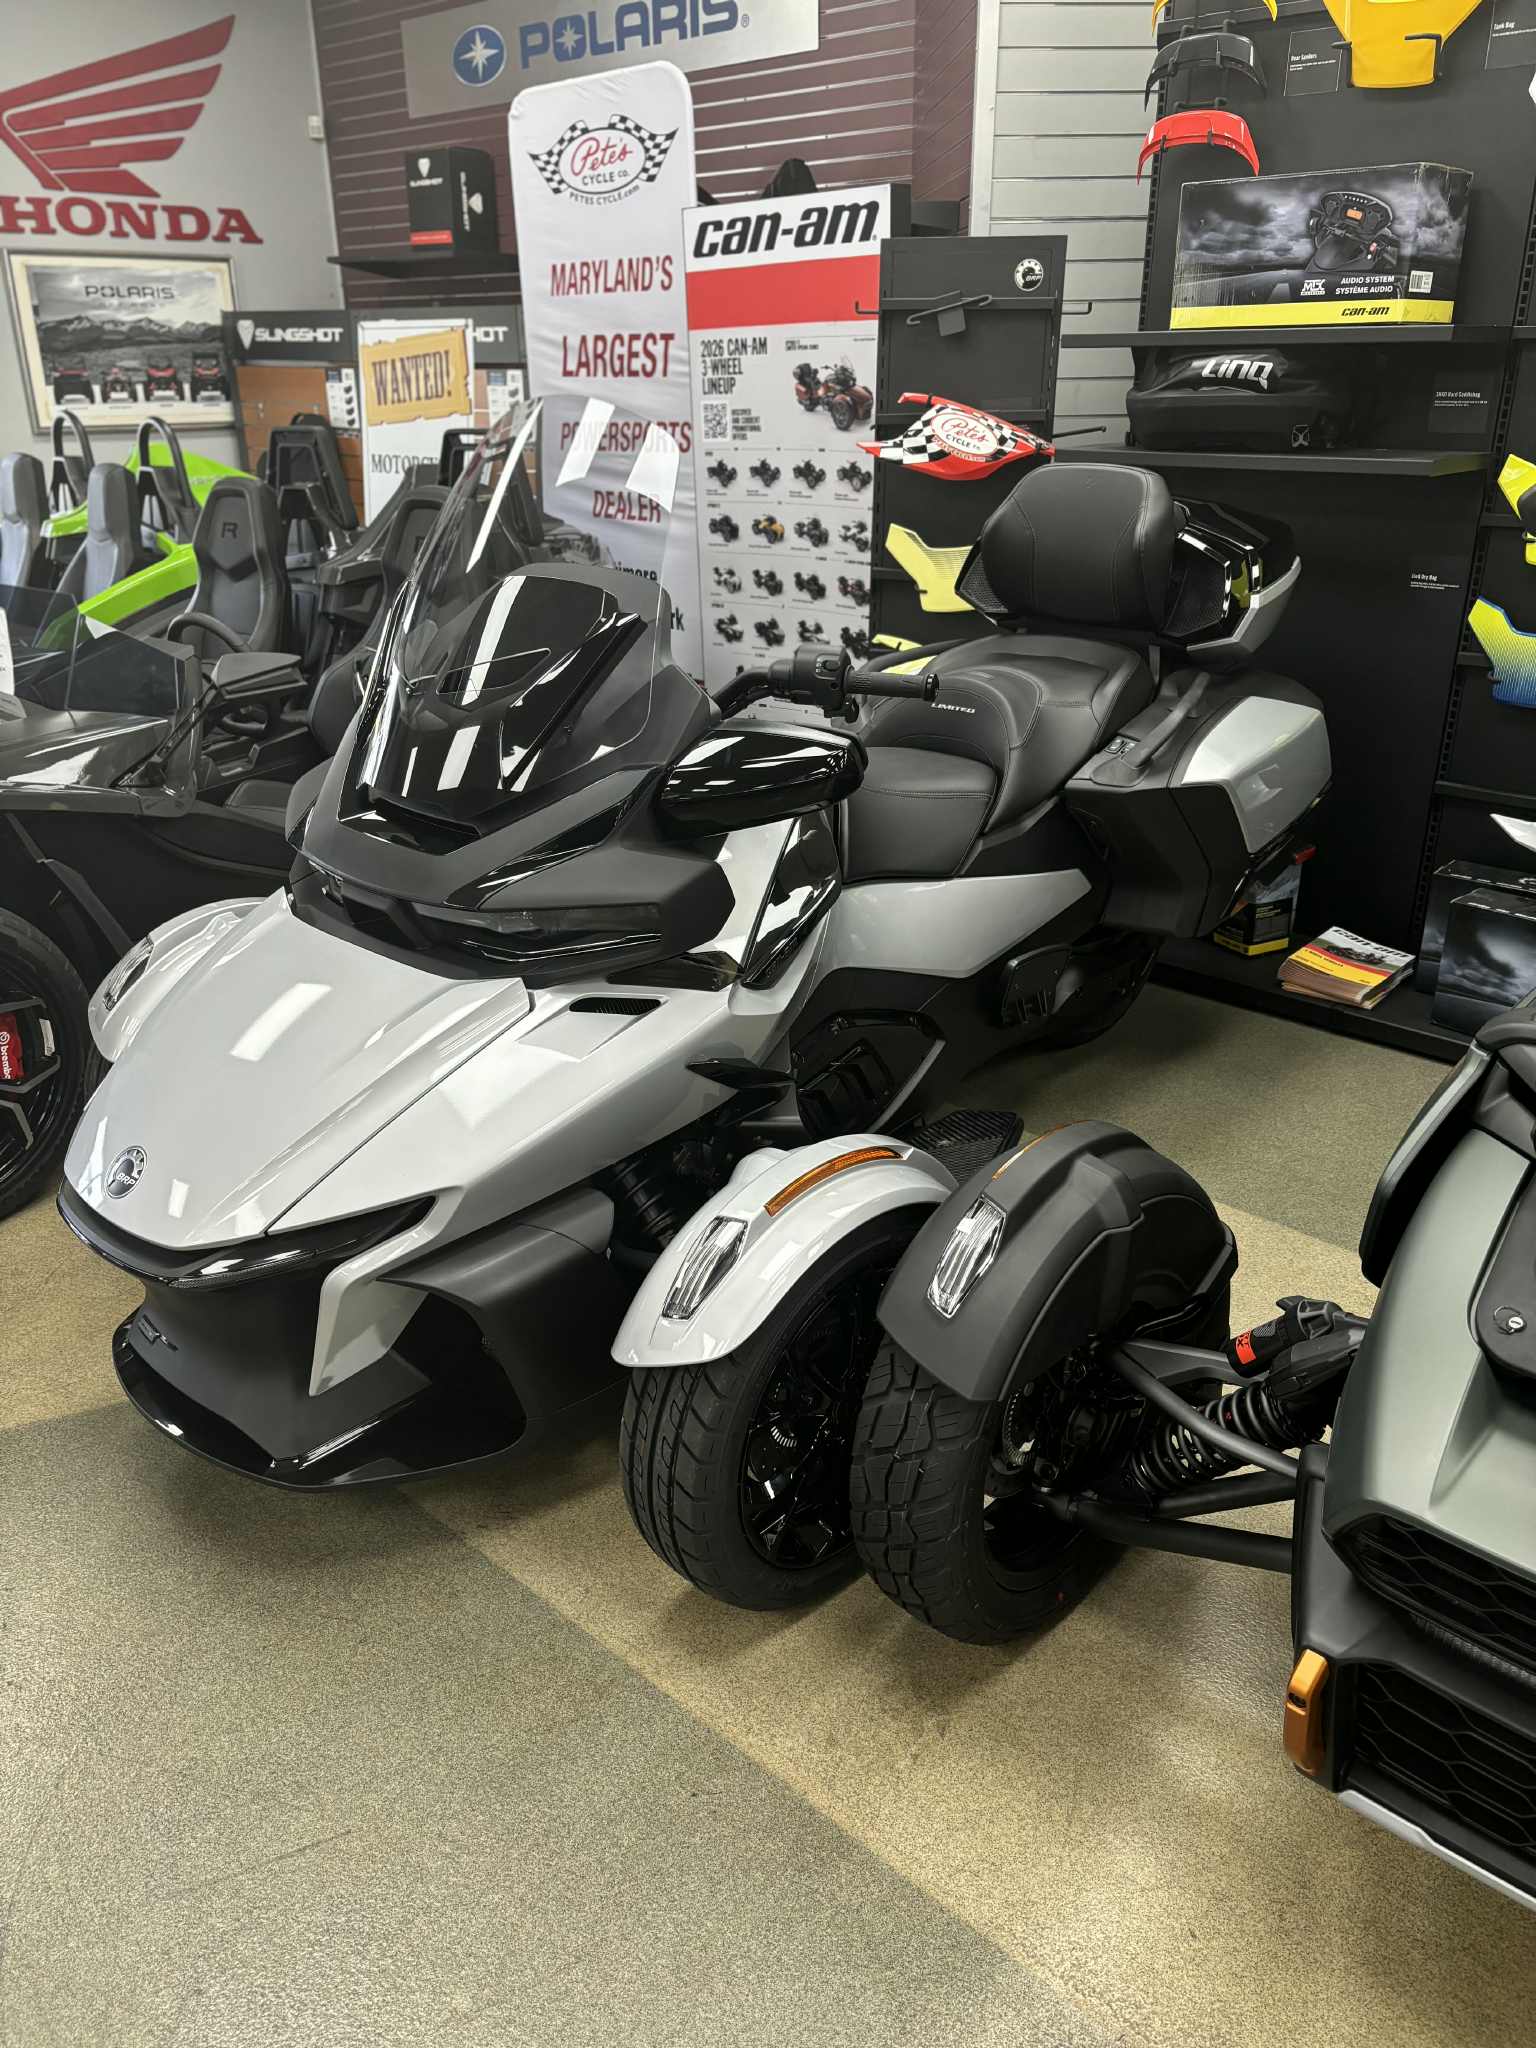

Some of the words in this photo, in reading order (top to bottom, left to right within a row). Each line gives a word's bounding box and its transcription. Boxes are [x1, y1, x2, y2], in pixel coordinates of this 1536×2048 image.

[519, 0, 738, 69] POLARIS
[571, 136, 633, 177] Pete's
[581, 171, 615, 186] CYCLE
[0, 196, 264, 245] HONDA
[693, 200, 880, 258] can-am
[550, 254, 673, 297] MARYLAND'S
[1340, 277, 1364, 285] AUDIO
[1365, 275, 1395, 284] SYSTEM
[84, 285, 176, 300] POLARIS
[1369, 285, 1393, 293] AUDIO
[1340, 306, 1390, 317] can-am
[254, 327, 344, 343] SLINGSHOT
[561, 333, 675, 378] LARGEST
[701, 339, 724, 358] 2026
[727, 336, 768, 356] CAN-AM
[702, 358, 744, 377] 3-WHEEL
[371, 350, 452, 407] WANTED!
[702, 377, 736, 396] LINEUP
[945, 433, 970, 449] CYCLE
[591, 489, 662, 523] DEALER
[931, 702, 976, 714] LIMITED
[0, 1044, 12, 1080] brembo
[116, 1172, 136, 1185] BRP
